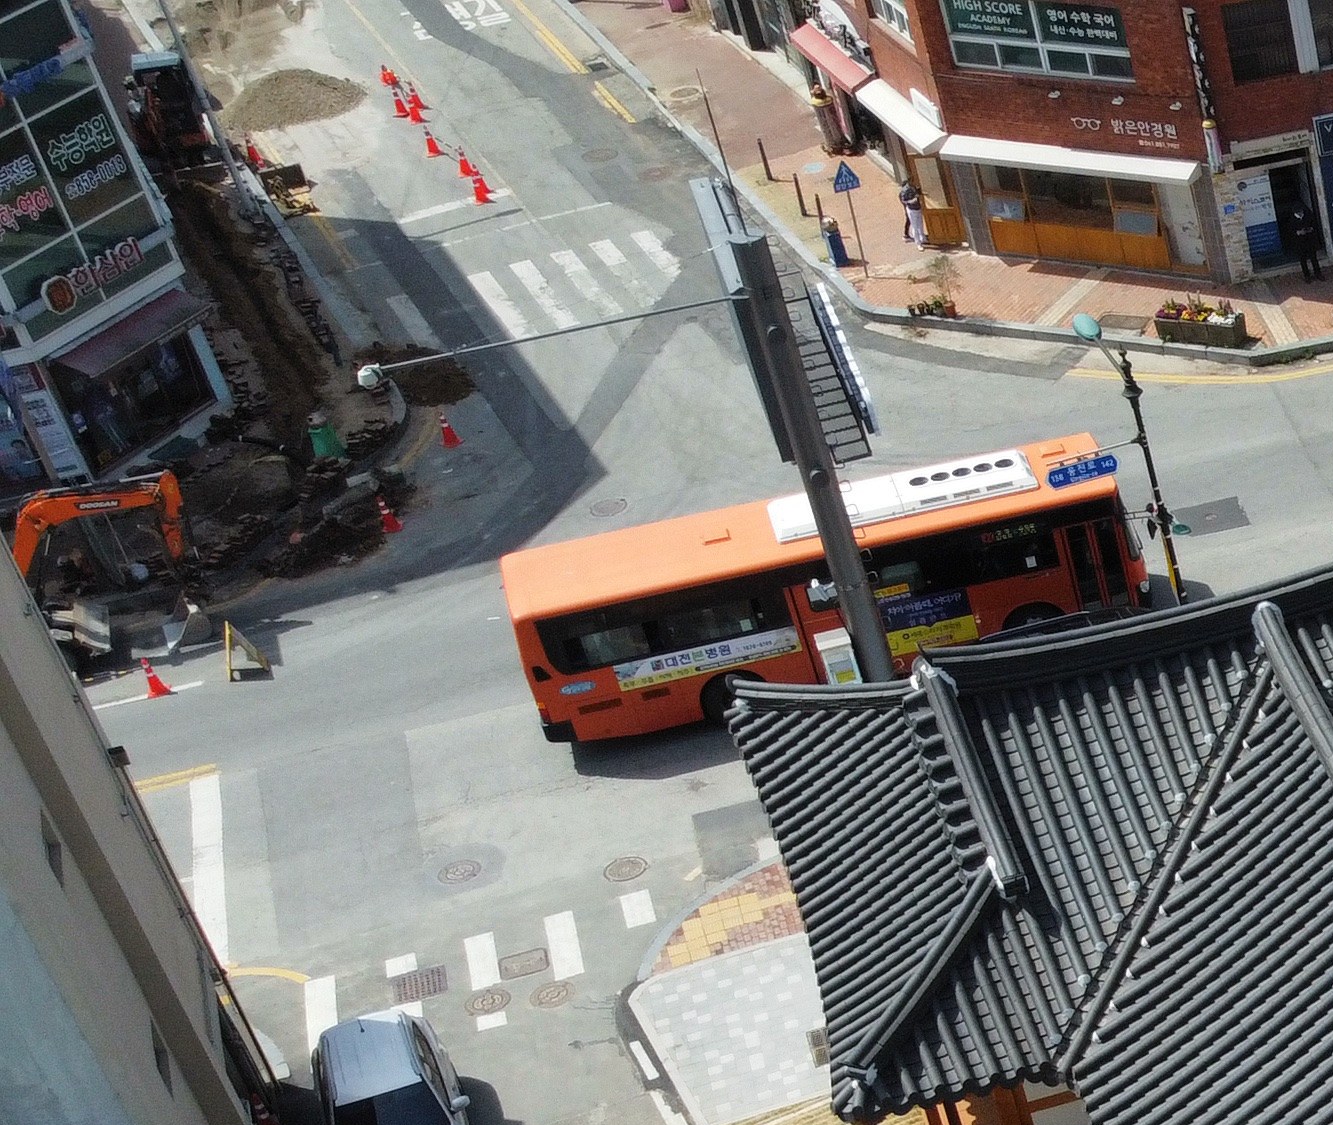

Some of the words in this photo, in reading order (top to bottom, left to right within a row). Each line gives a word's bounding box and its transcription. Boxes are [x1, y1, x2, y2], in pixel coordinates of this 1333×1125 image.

[953, 0, 983, 12] HIGH
[986, 2, 1023, 15] SCORE
[970, 14, 1011, 25] ACADEMY
[1046, 9, 1068, 23] 영어
[1070, 11, 1091, 25] 수학
[1093, 13, 1115, 27] 국어
[1110, 118, 1178, 139] 밝은안경원
[47, 114, 115, 171] 수능학원
[1100, 459, 1115, 468] 142
[79, 500, 118, 510] DOOSAN
